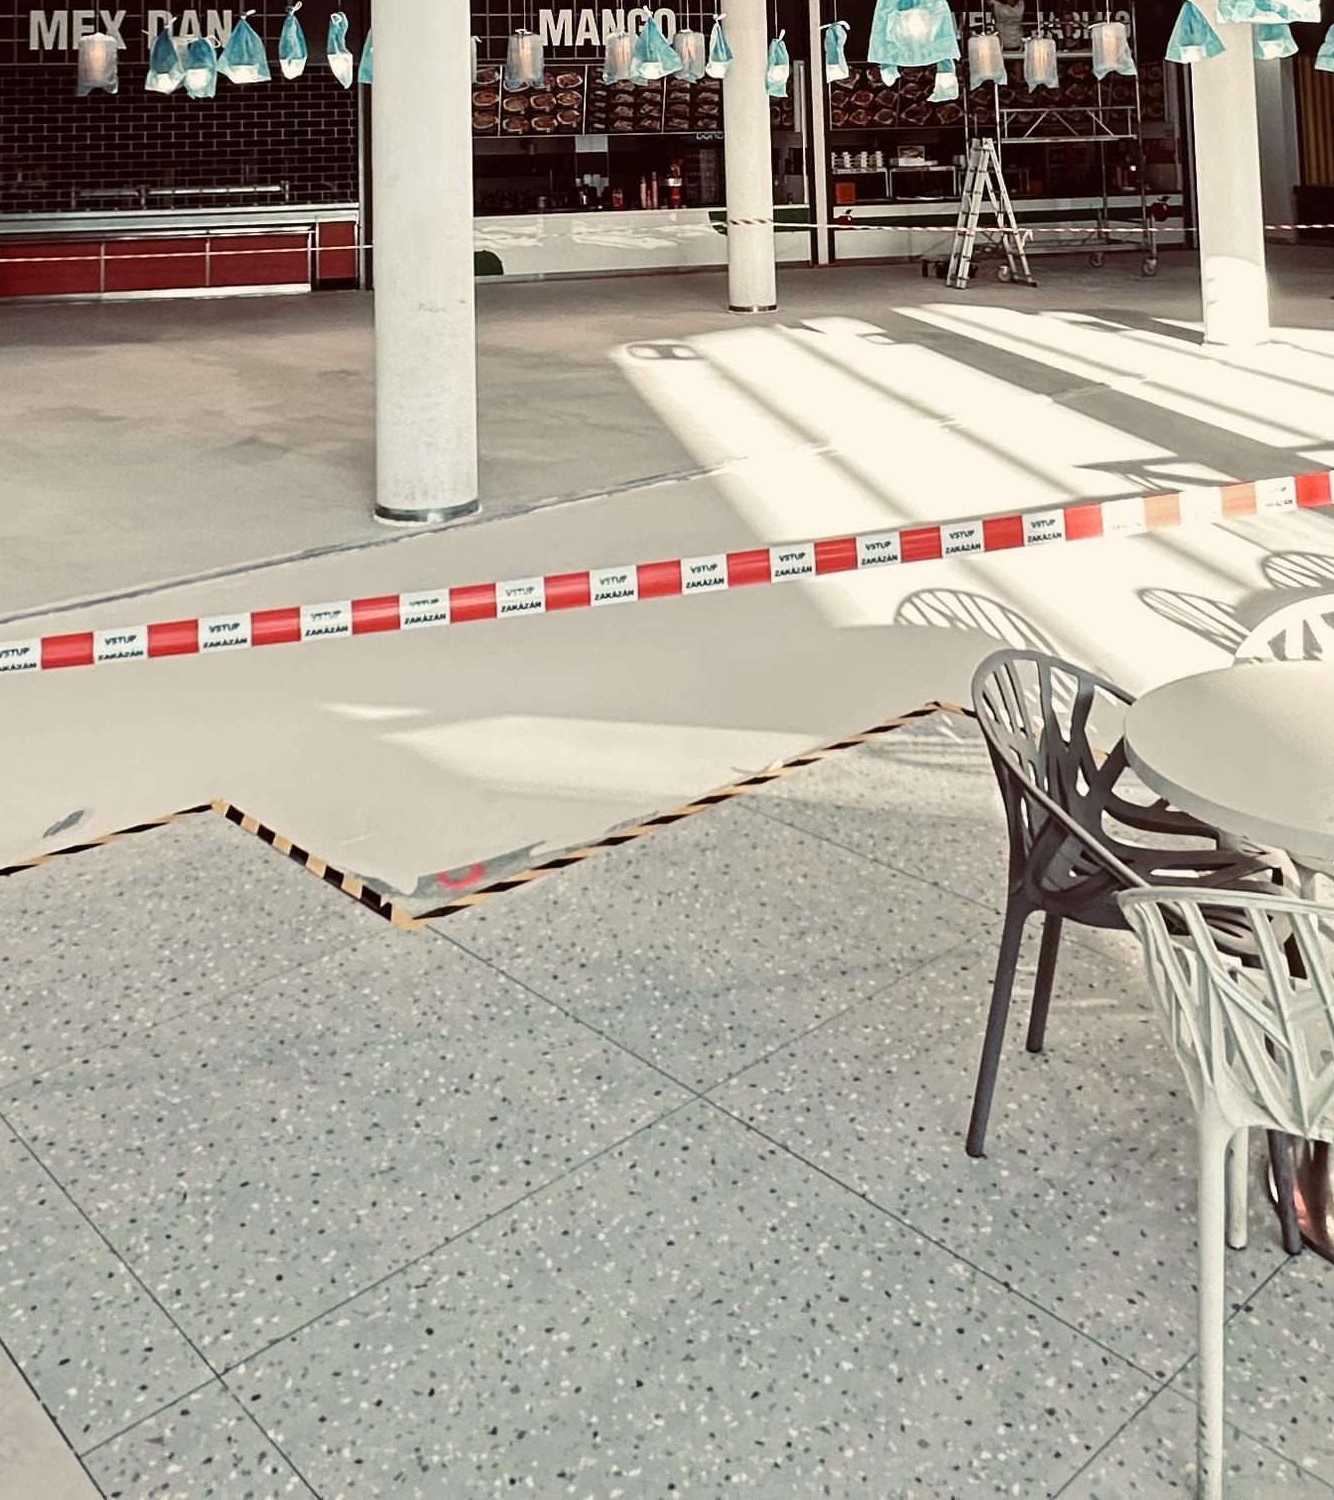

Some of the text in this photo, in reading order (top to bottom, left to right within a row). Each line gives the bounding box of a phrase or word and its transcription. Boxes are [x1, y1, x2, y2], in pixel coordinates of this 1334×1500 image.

[29, 9, 127, 50] MEX
[539, 8, 677, 47] MANGO
[1031, 519, 1055, 529] VSTUP
[949, 530, 974, 539] VSTUP
[865, 541, 891, 551] VSTUP
[779, 552, 805, 562] VSTUP
[690, 564, 717, 573] VSTUP
[209, 623, 240, 633] VSTUP
[105, 635, 136, 645] VSTUP
